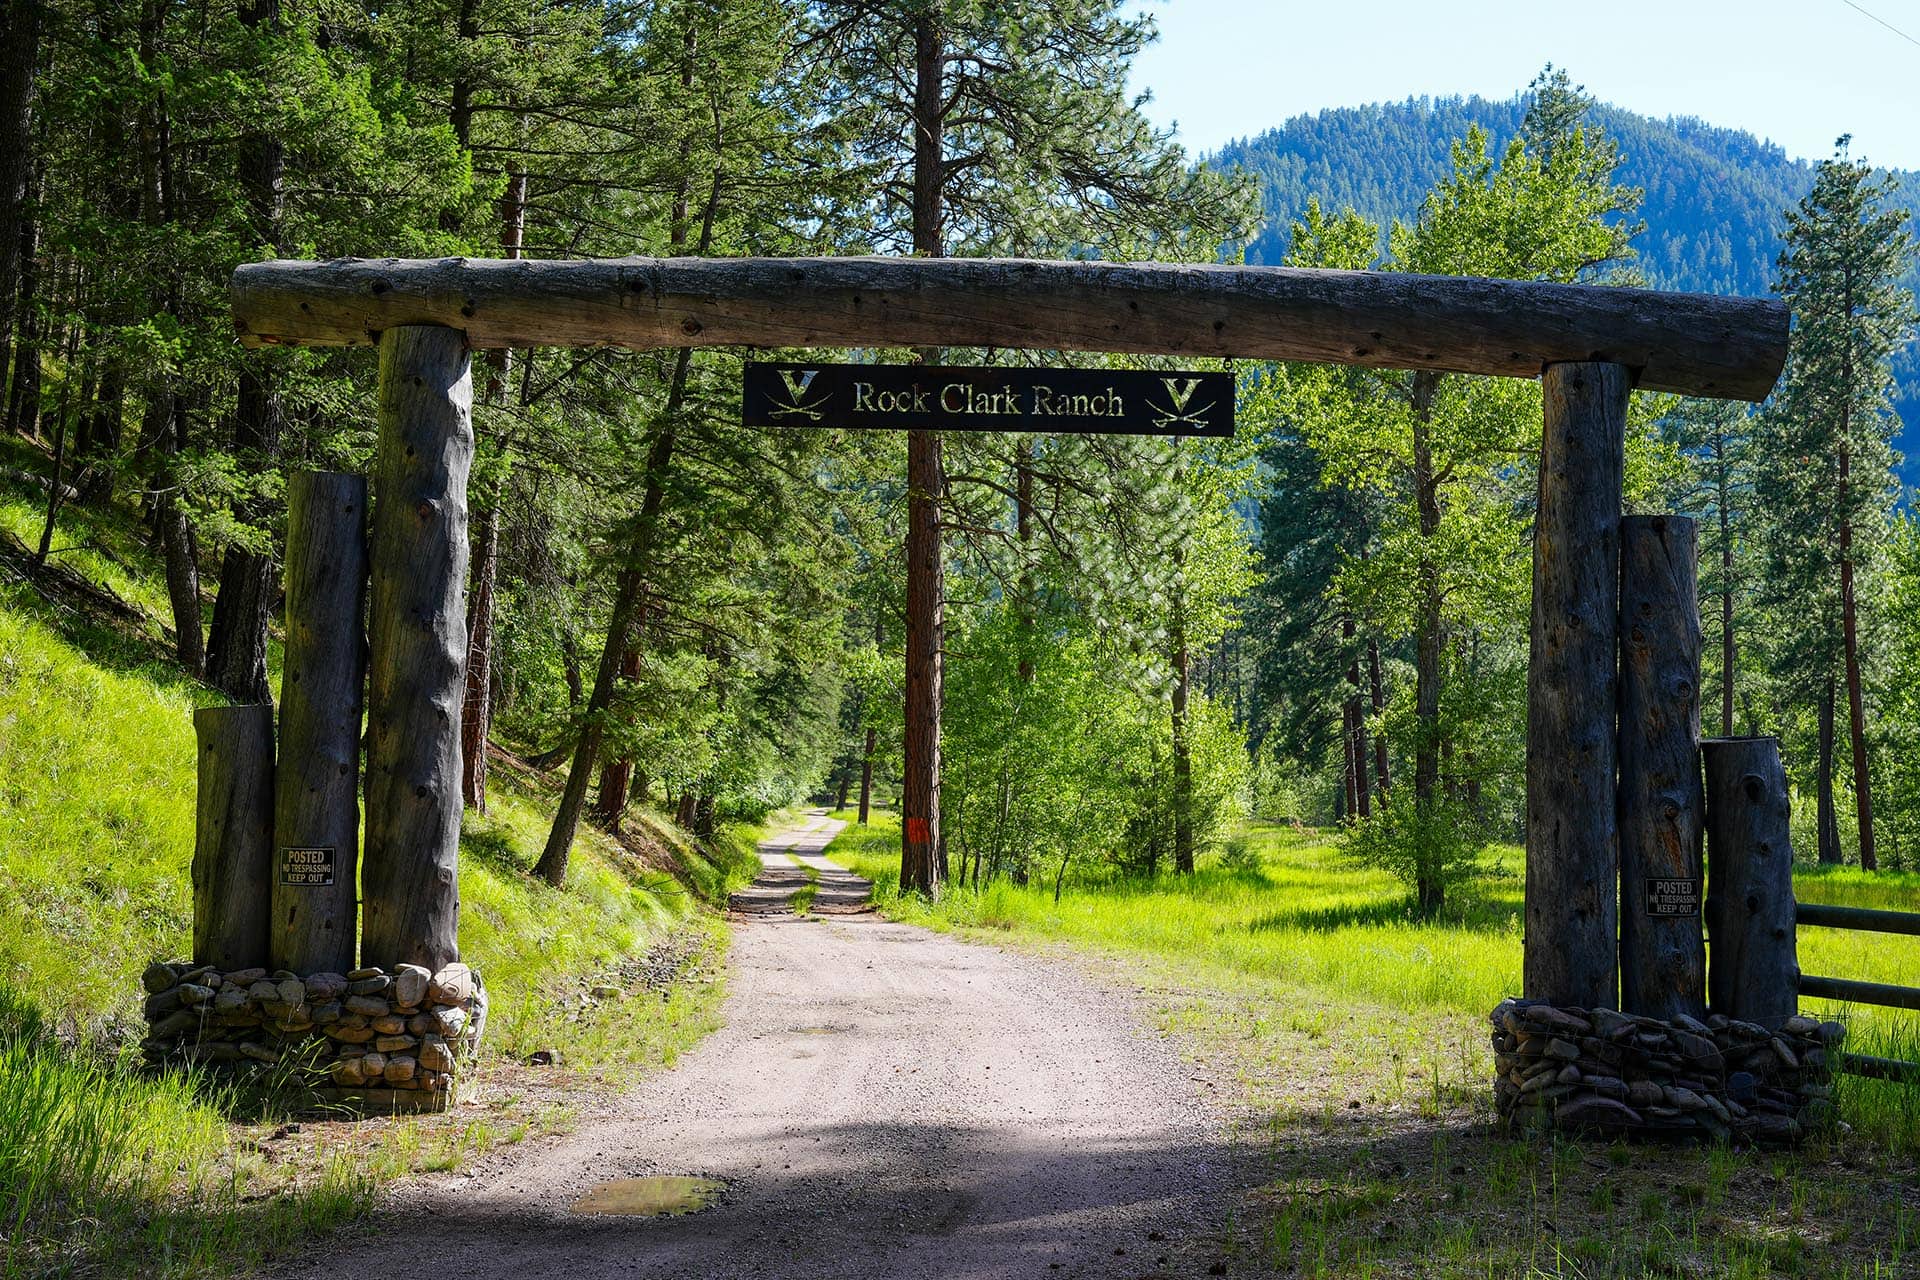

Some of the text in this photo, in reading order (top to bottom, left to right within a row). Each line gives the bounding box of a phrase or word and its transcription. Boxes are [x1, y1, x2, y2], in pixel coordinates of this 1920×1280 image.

[852, 381, 1125, 417] Rock Clark Ranch
[288, 850, 324, 863] POSTED
[282, 863, 331, 873] NO TRESPASSING
[287, 873, 324, 882] KEEP OUT
[1656, 881, 1692, 894] POSTED
[1649, 895, 1659, 904] NO
[1656, 904, 1693, 913] KEEP OUT
